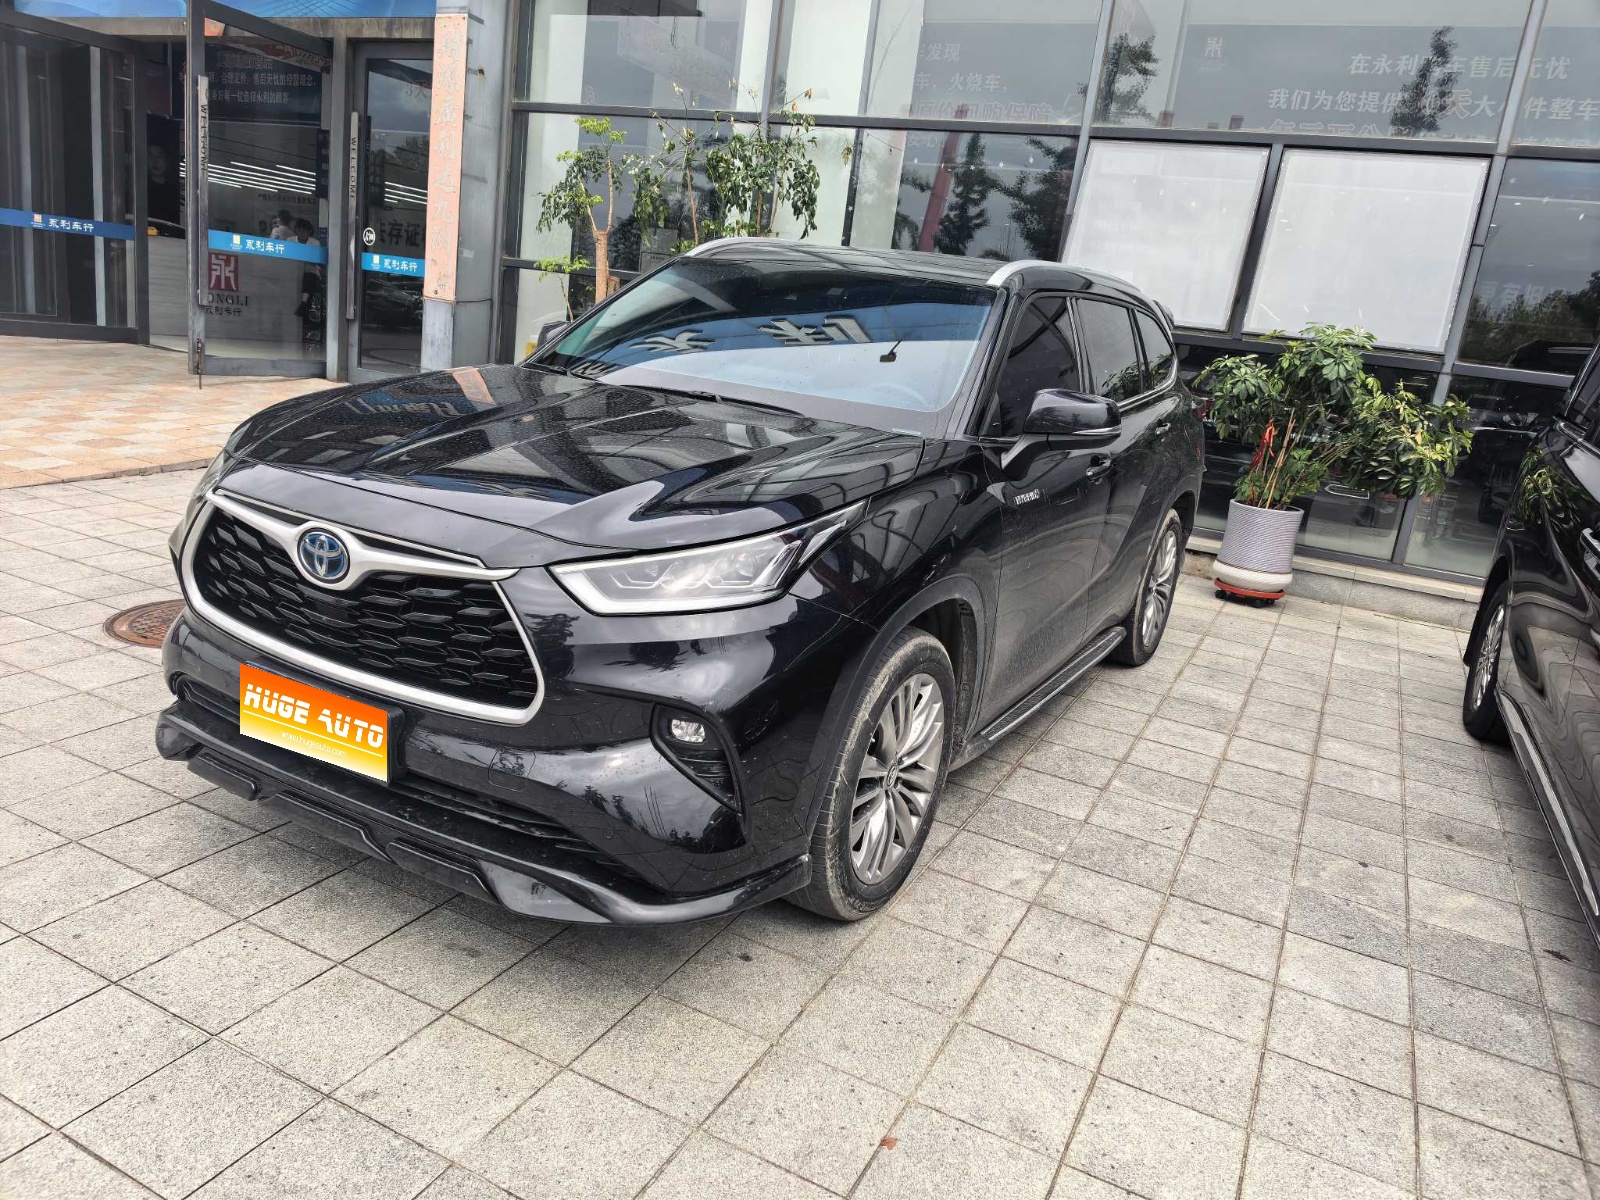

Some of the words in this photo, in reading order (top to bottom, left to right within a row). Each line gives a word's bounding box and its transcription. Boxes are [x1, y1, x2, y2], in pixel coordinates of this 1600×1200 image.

[1349, 53, 1571, 80] 在永利车售后忧
[48, 218, 95, 233] 永利车行
[245, 239, 285, 254] 永利车行
[384, 258, 418, 273] 永利车行
[207, 292, 249, 307] ONGLI
